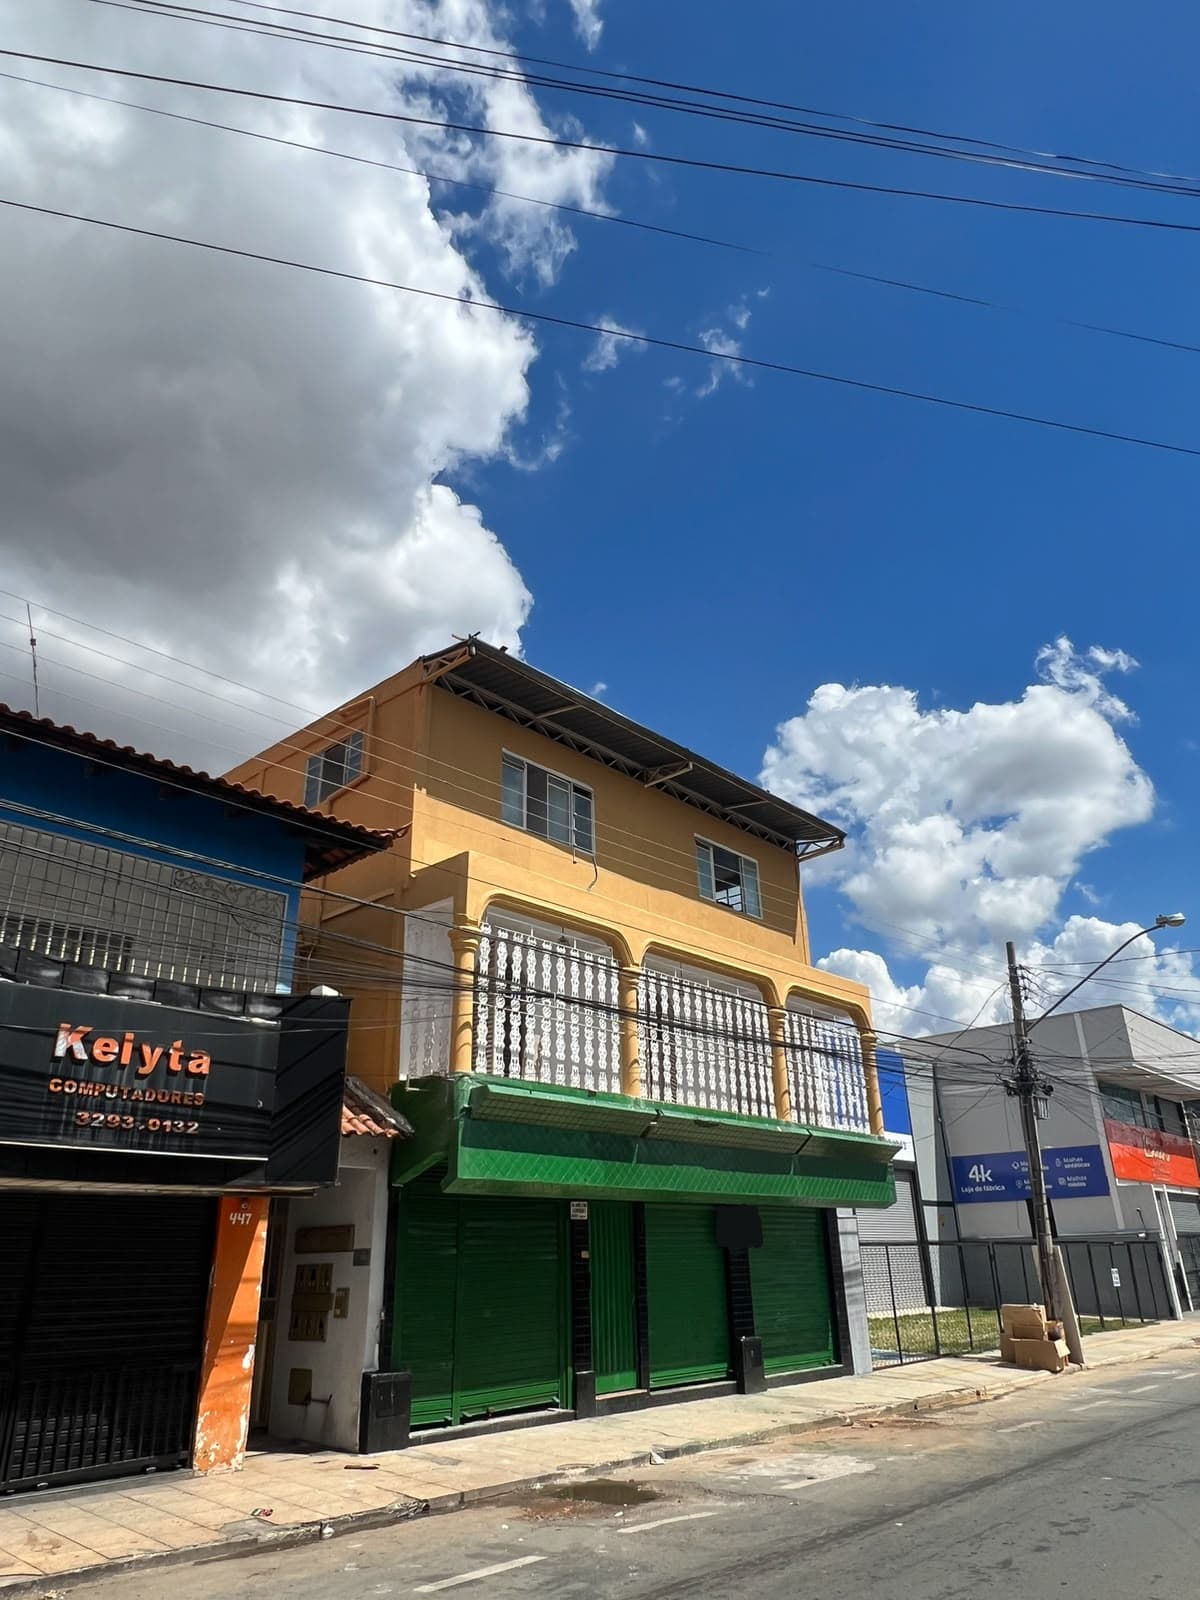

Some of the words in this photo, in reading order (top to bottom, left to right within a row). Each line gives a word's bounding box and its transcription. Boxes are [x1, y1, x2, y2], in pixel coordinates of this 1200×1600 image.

[54, 1023, 211, 1075] Keiyta
[49, 1078, 206, 1106] COMPUTADORES
[961, 1187, 974, 1195] Loja
[983, 1184, 1006, 1192] fábrica
[229, 1212, 253, 1225] 447
